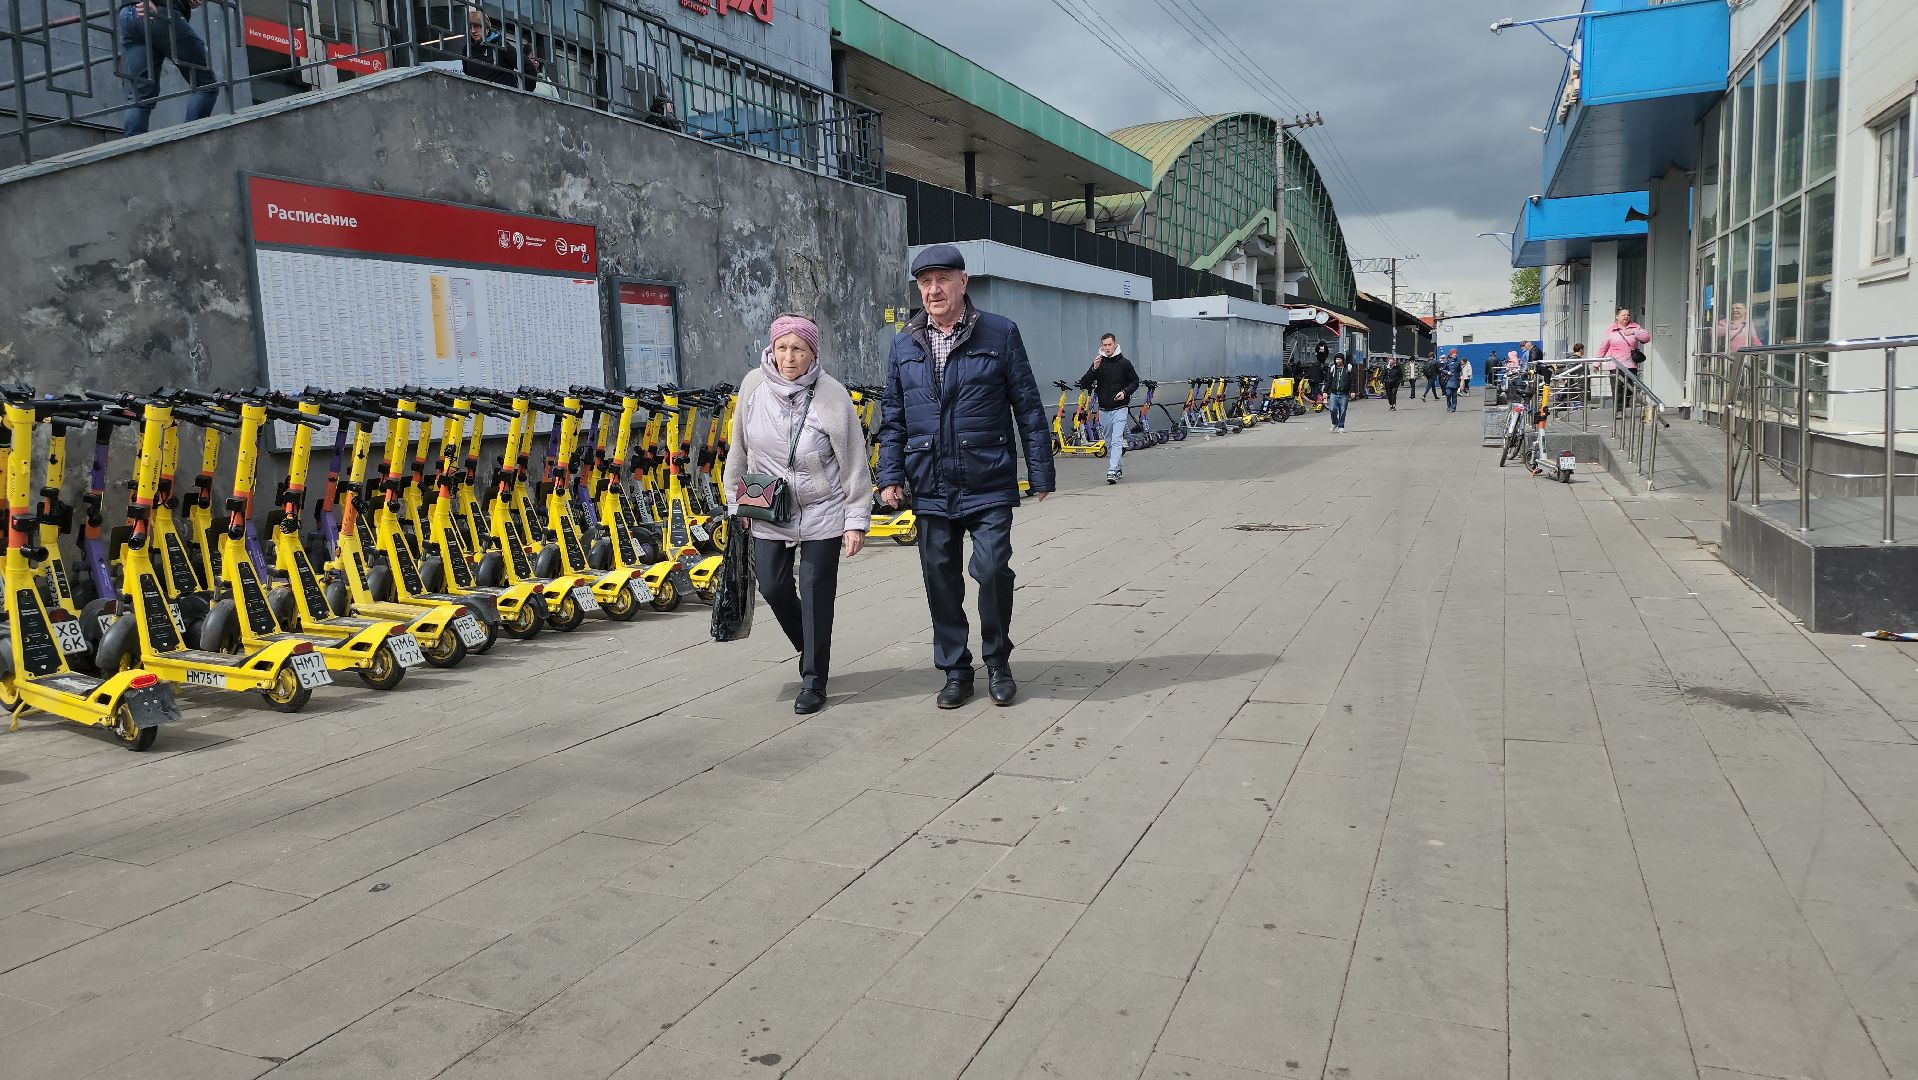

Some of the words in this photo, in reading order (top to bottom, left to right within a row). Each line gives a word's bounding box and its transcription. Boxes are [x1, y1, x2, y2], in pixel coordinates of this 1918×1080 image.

[267, 203, 358, 228] Расписание
[54, 622, 80, 638] Х8
[62, 636, 85, 652] 6К
